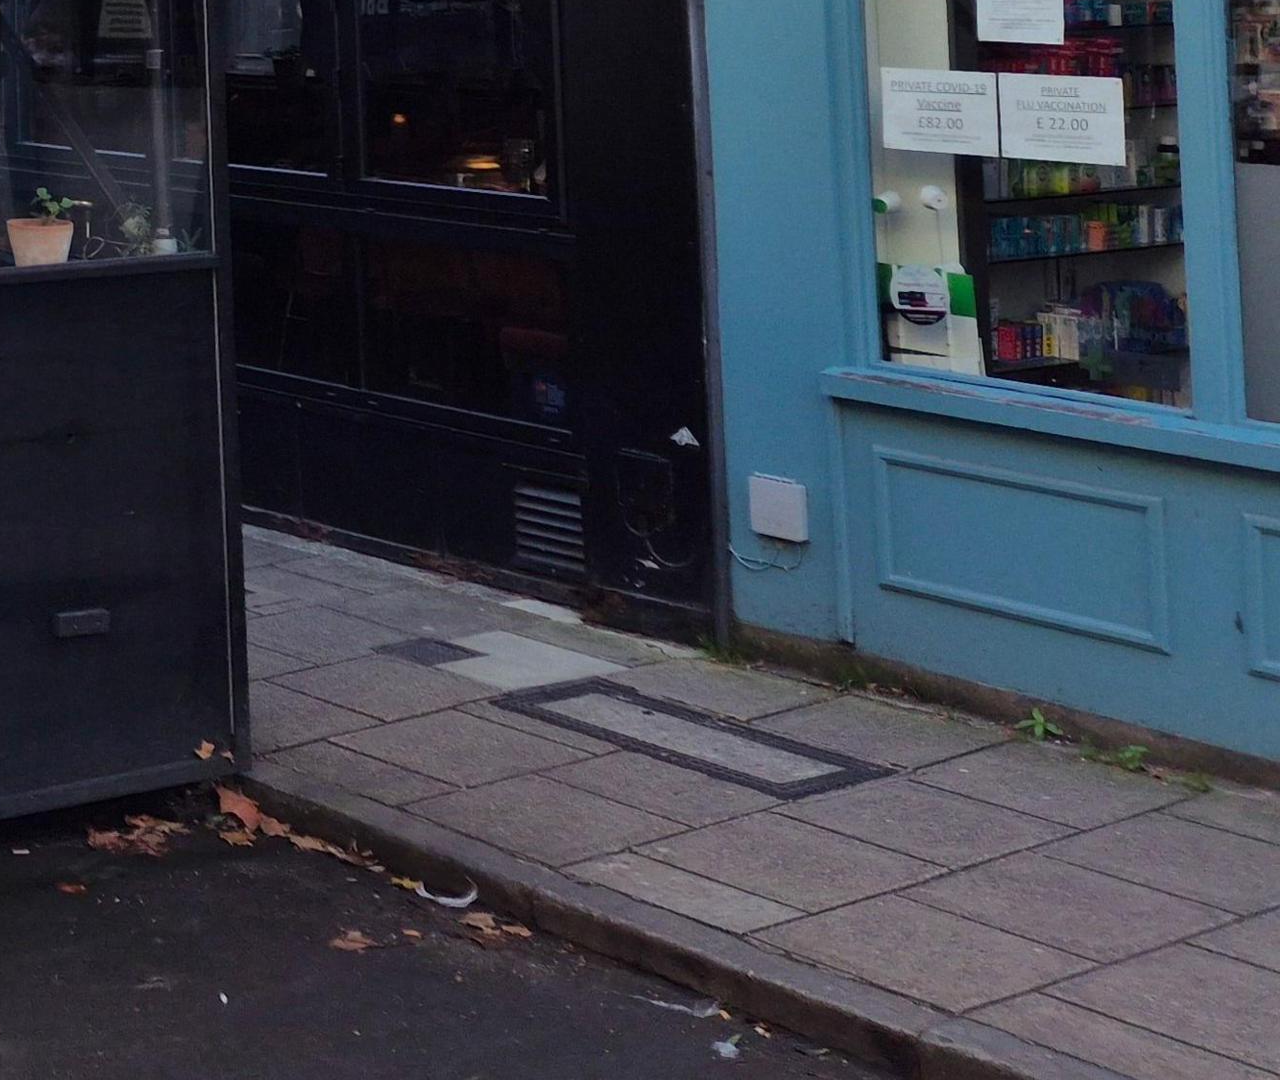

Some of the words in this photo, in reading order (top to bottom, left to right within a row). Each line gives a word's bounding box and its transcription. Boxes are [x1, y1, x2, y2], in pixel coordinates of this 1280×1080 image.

[891, 81, 933, 93] PRIVATE
[936, 83, 987, 94] COVID-19
[1041, 87, 1079, 97] PRIVATE
[916, 98, 962, 111] Vaccine
[1038, 101, 1106, 112] VACCINATION
[1050, 119, 1089, 131] 22.00
